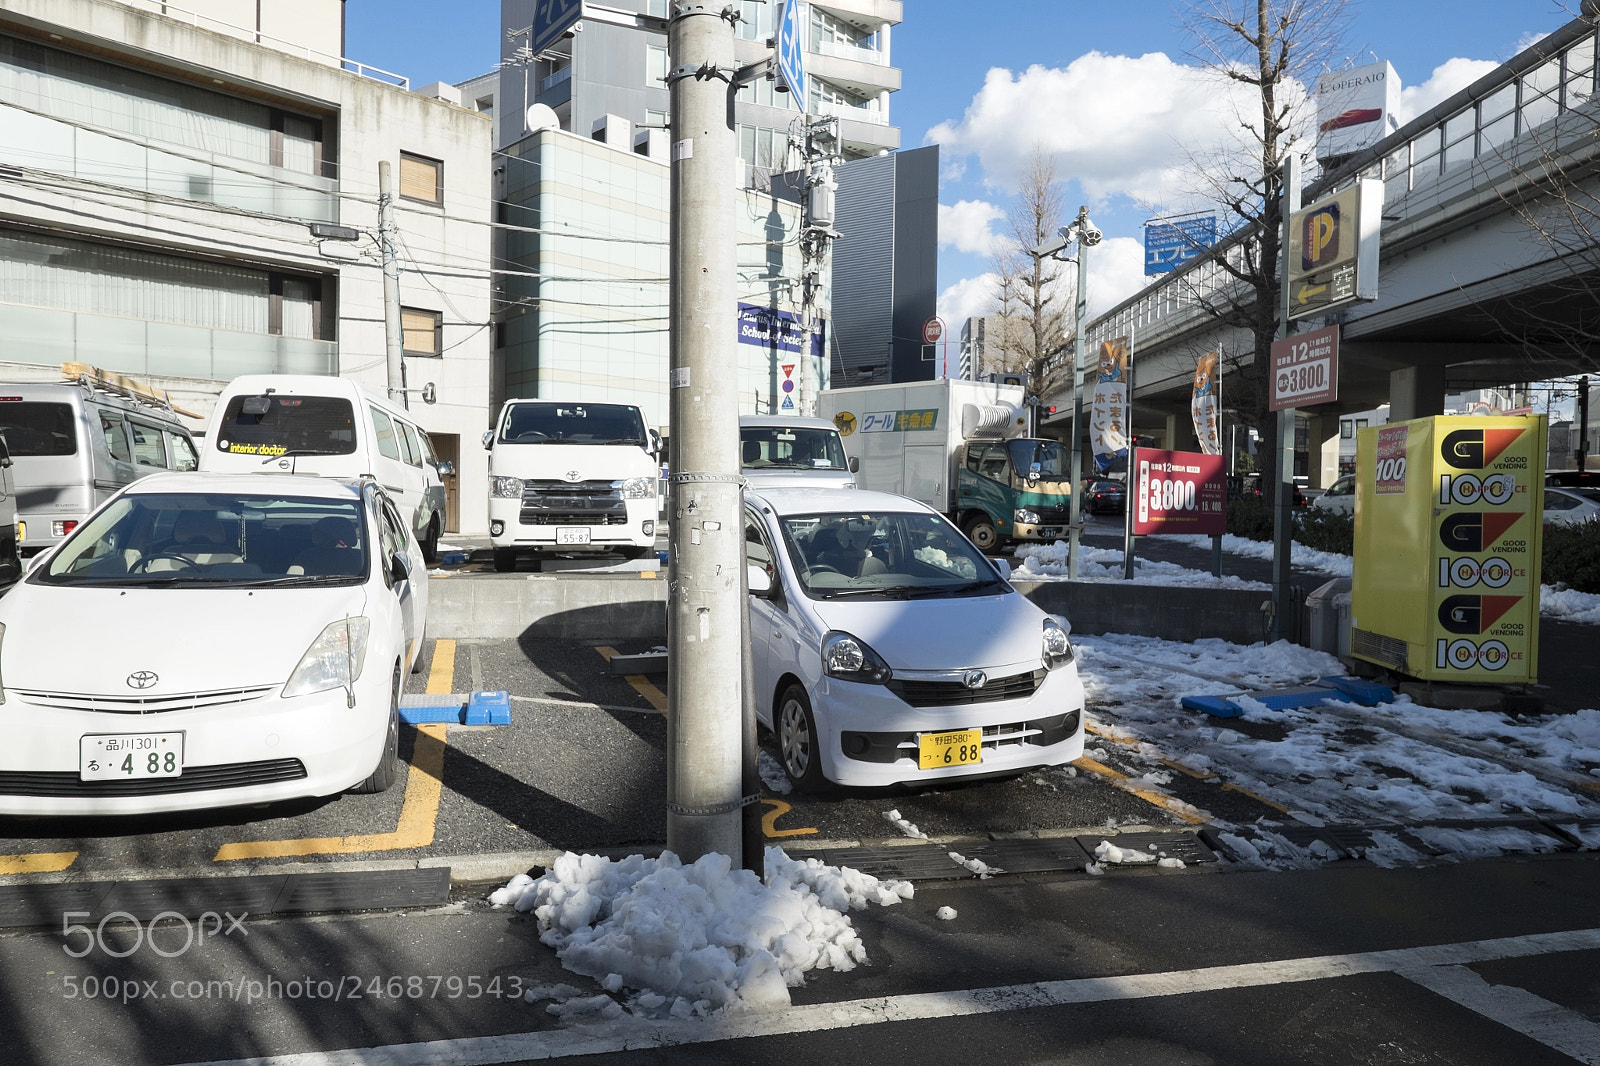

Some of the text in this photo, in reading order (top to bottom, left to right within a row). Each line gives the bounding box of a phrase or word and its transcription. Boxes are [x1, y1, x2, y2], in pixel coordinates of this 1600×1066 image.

[742, 325, 770, 340] School
[230, 442, 287, 456] interior doctor
[1376, 457, 1407, 481] 100
[1440, 473, 1514, 505] 100
[1439, 556, 1512, 588] 100
[1461, 569, 1526, 577] HAPPY PRICE
[1436, 638, 1510, 671] 100
[1459, 651, 1523, 660] HAPPY PRICE
[106, 738, 157, 751] 品川301
